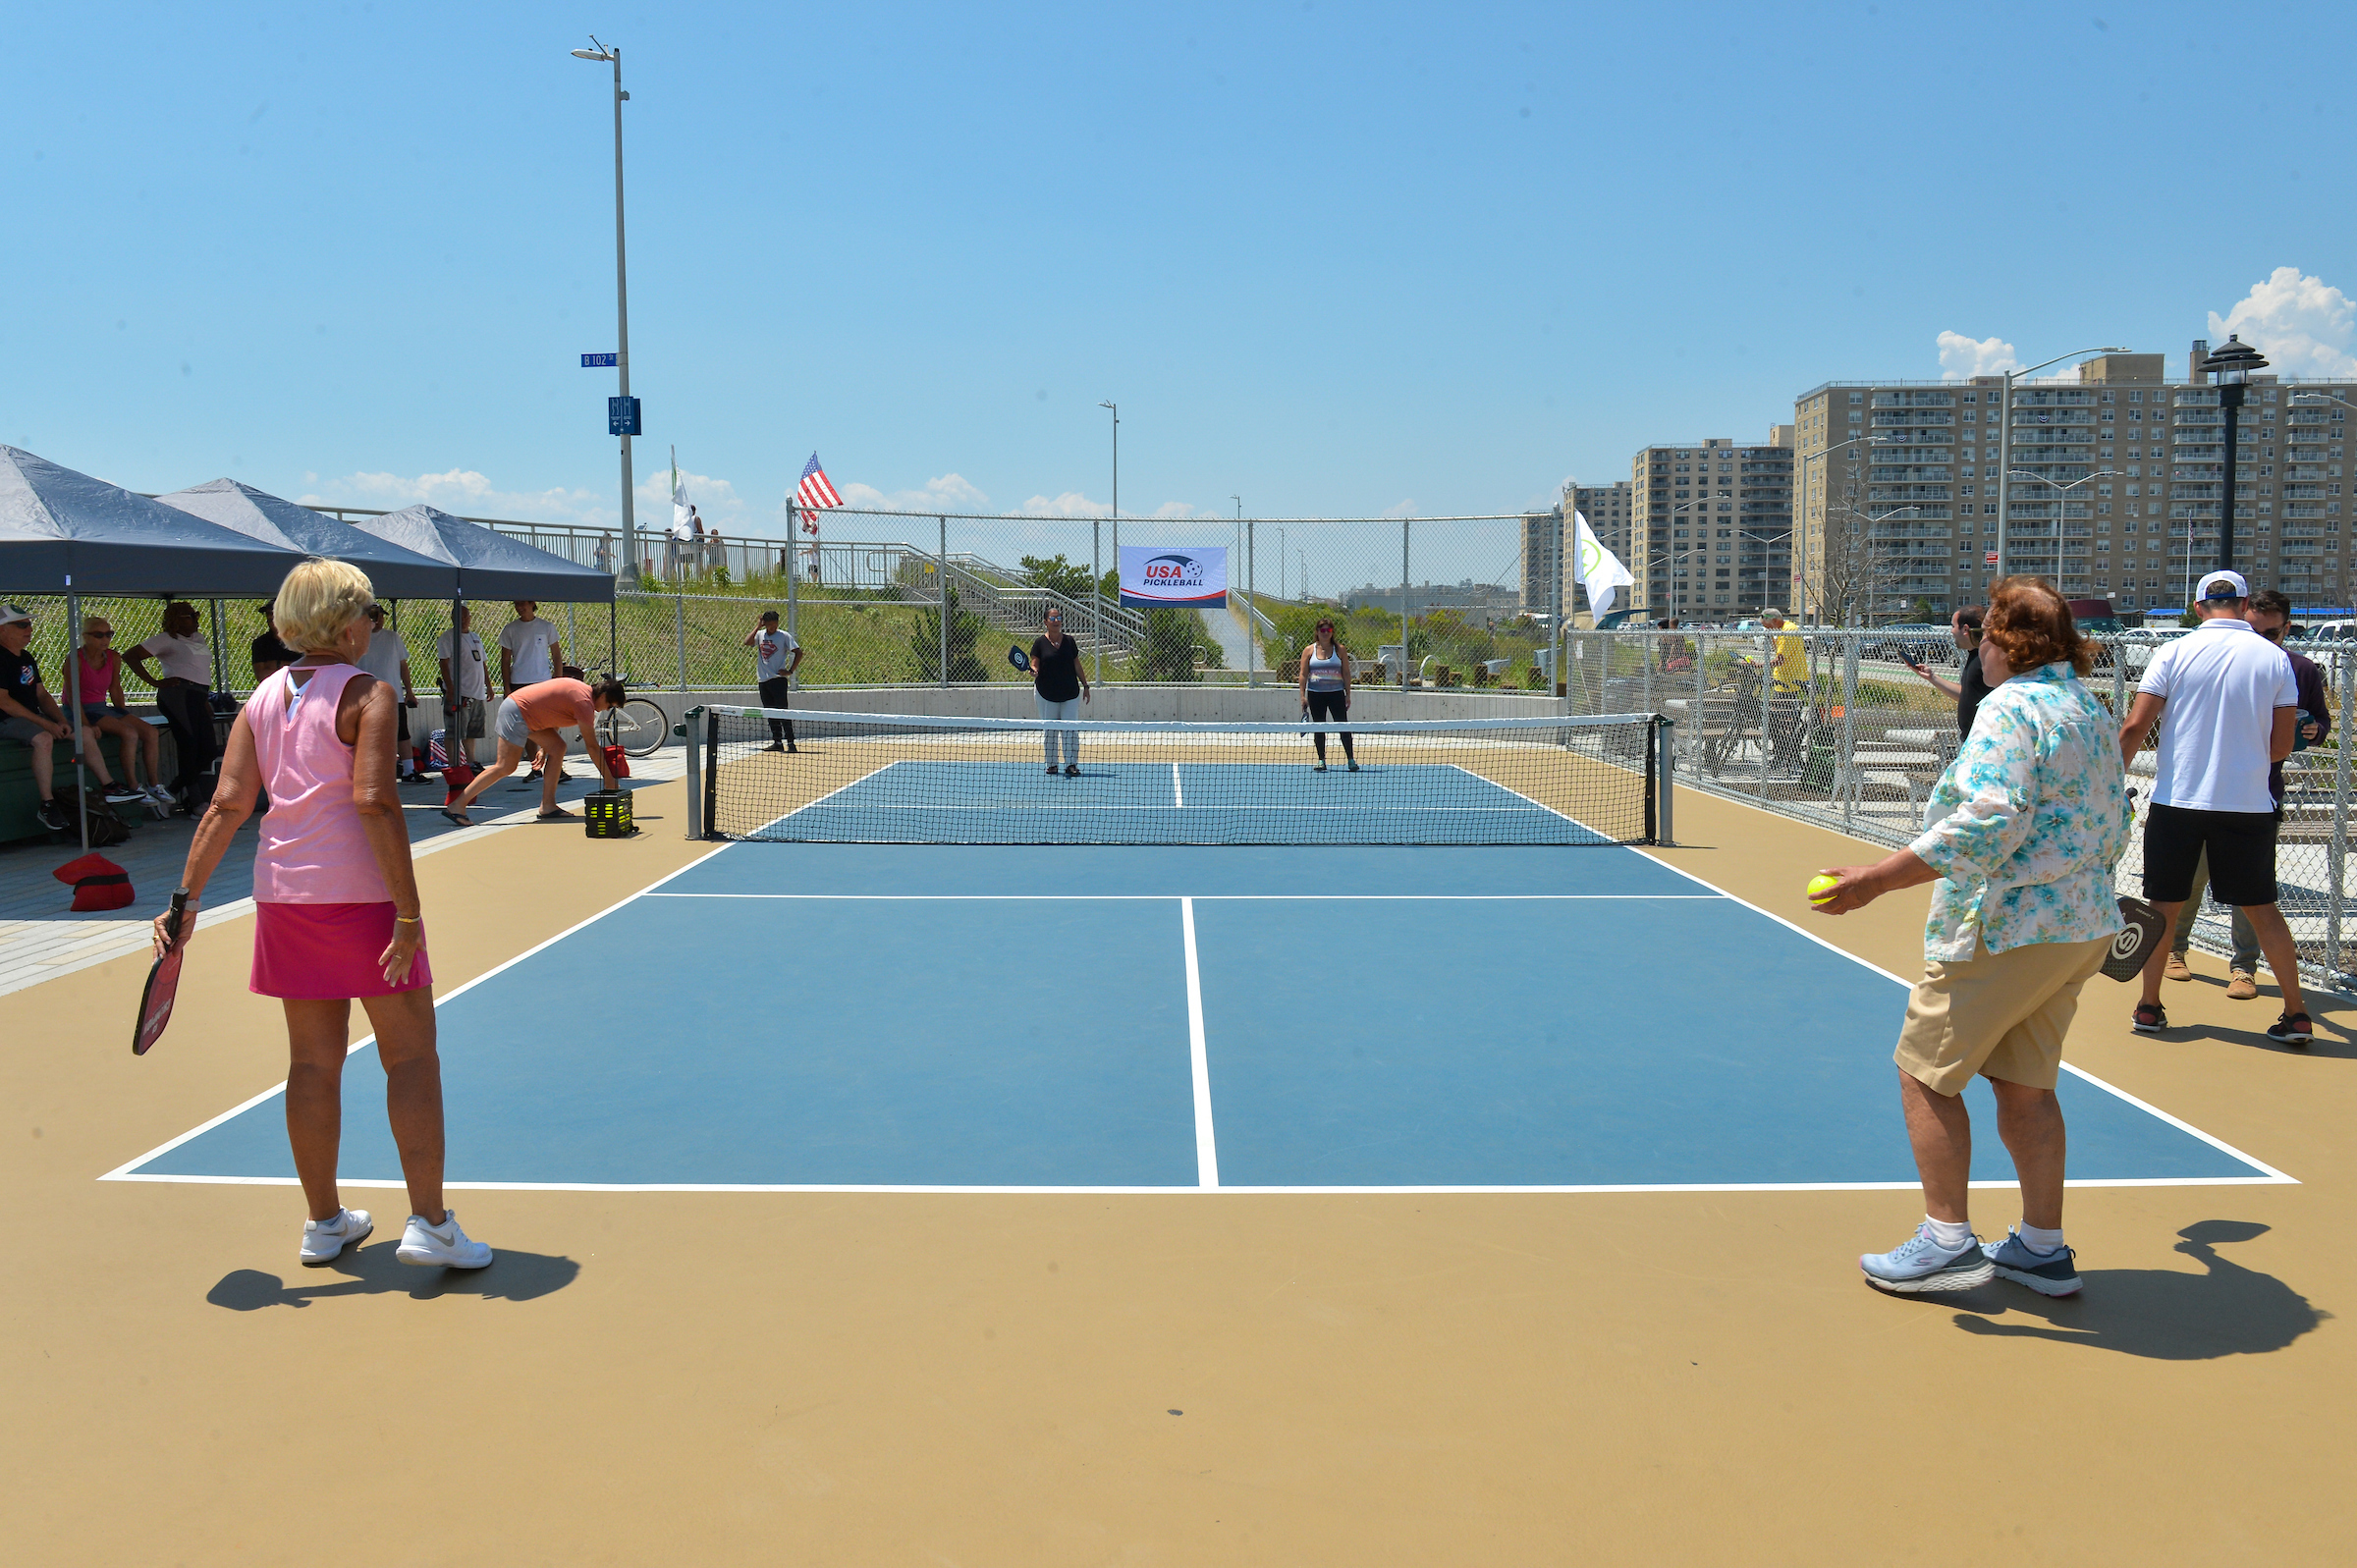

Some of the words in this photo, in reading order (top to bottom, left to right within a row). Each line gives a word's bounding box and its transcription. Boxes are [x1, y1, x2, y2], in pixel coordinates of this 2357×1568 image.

[584, 355, 590, 366] B
[592, 354, 607, 365] 102
[1146, 566, 1181, 578] USA
